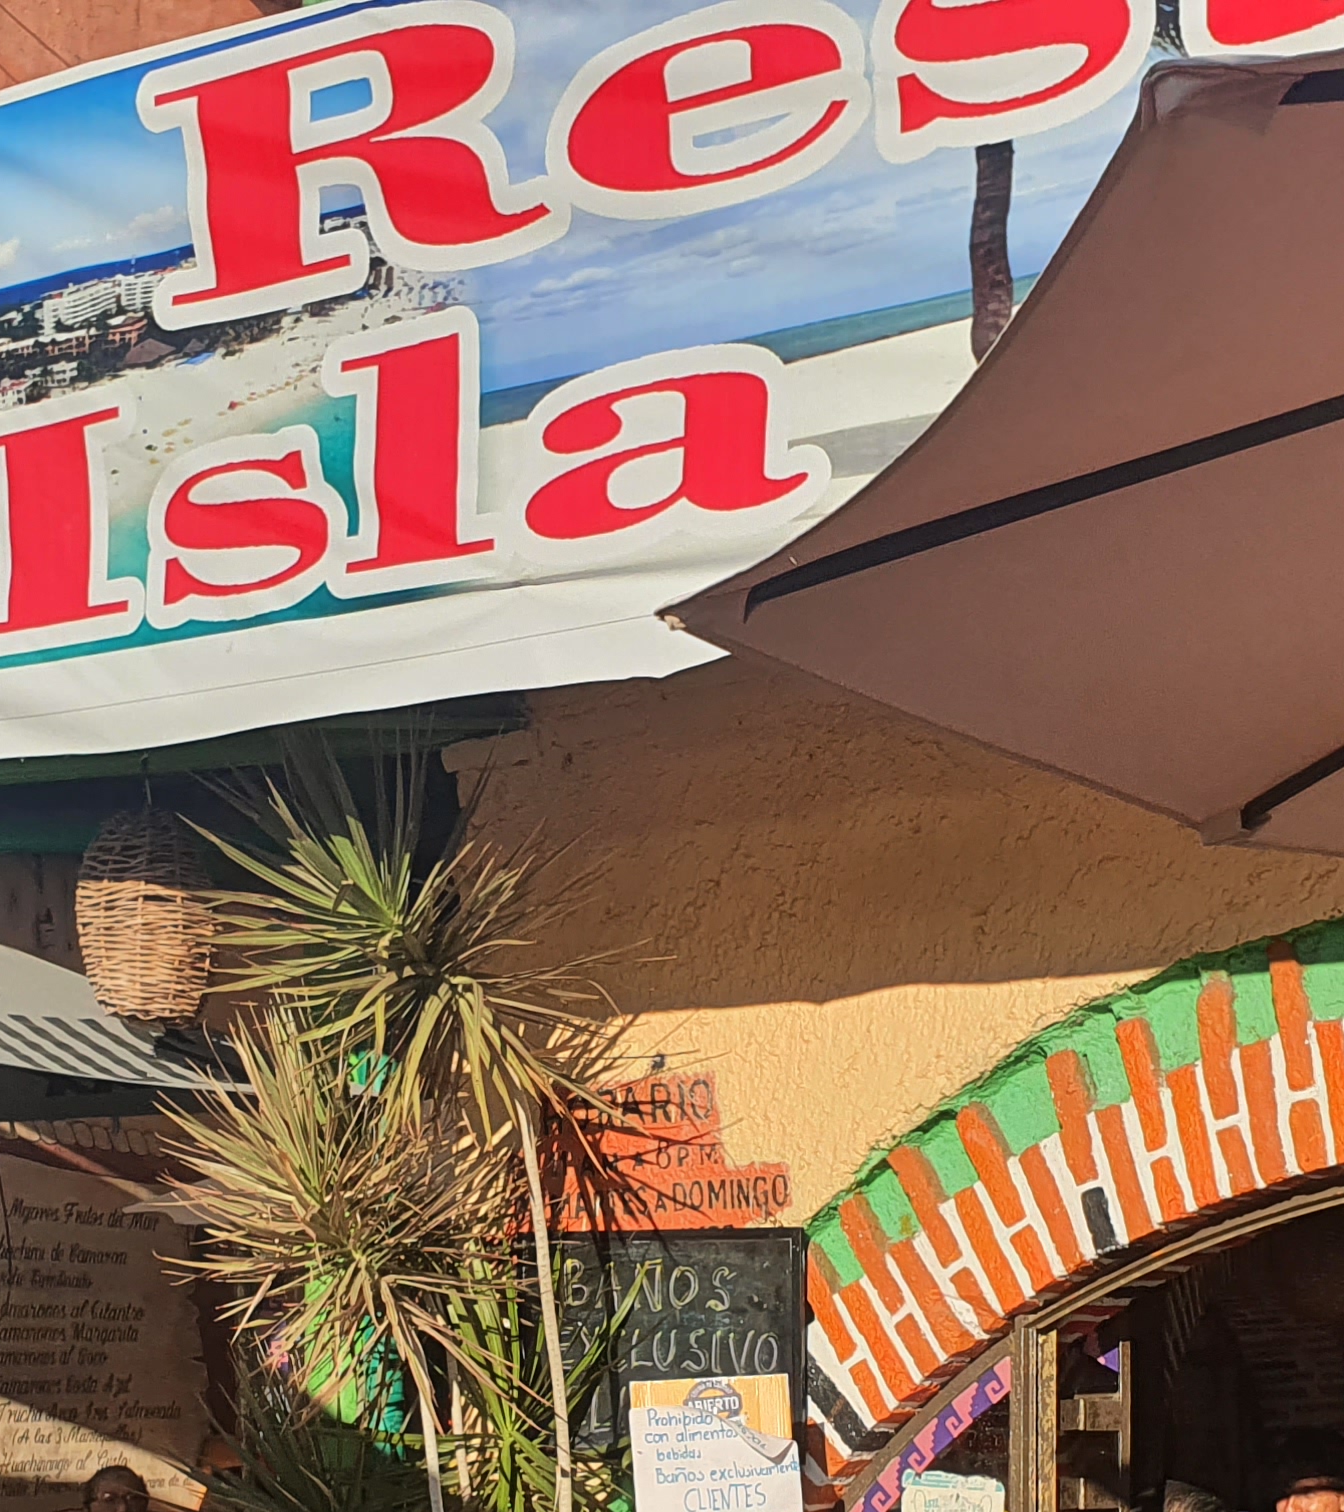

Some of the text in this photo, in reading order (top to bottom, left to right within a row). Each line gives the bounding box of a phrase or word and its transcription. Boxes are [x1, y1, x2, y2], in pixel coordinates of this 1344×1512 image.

[672, 1174, 791, 1222] DOMINGO
[563, 1258, 737, 1312] BAÑOS
[644, 1432, 669, 1445] con
[675, 1421, 739, 1443] alimentos
[655, 1466, 705, 1485] Baños
